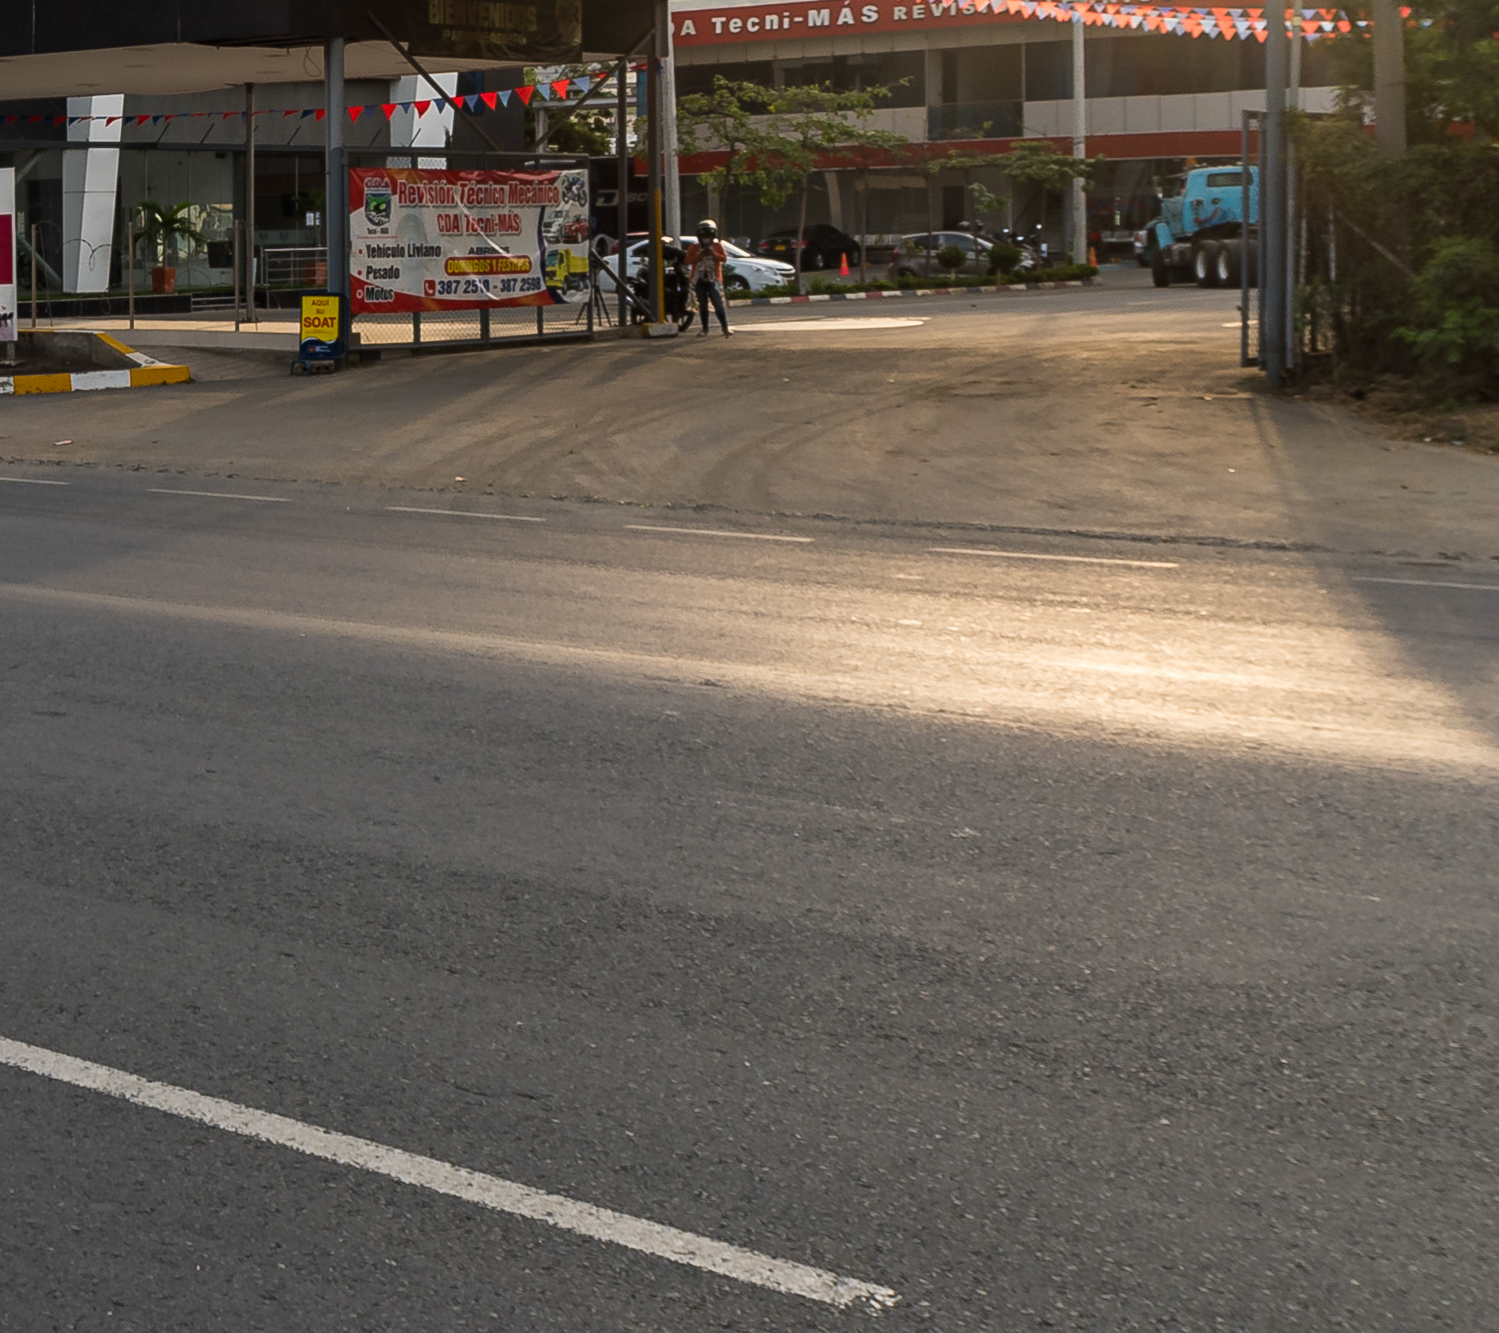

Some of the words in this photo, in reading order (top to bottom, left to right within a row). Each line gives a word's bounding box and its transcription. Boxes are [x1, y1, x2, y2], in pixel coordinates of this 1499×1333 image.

[711, 0, 879, 34] Tecni-MÁS
[459, 181, 504, 205] Técnico
[508, 181, 560, 205] Mecánico
[437, 214, 460, 233] CDA
[407, 243, 441, 258] Liviano
[365, 265, 400, 280] Pesado
[447, 259, 490, 273] DOMINGOS
[492, 259, 497, 272] Y
[438, 280, 461, 294] 387
[500, 278, 518, 292] 387
[304, 316, 337, 328] SOAT
